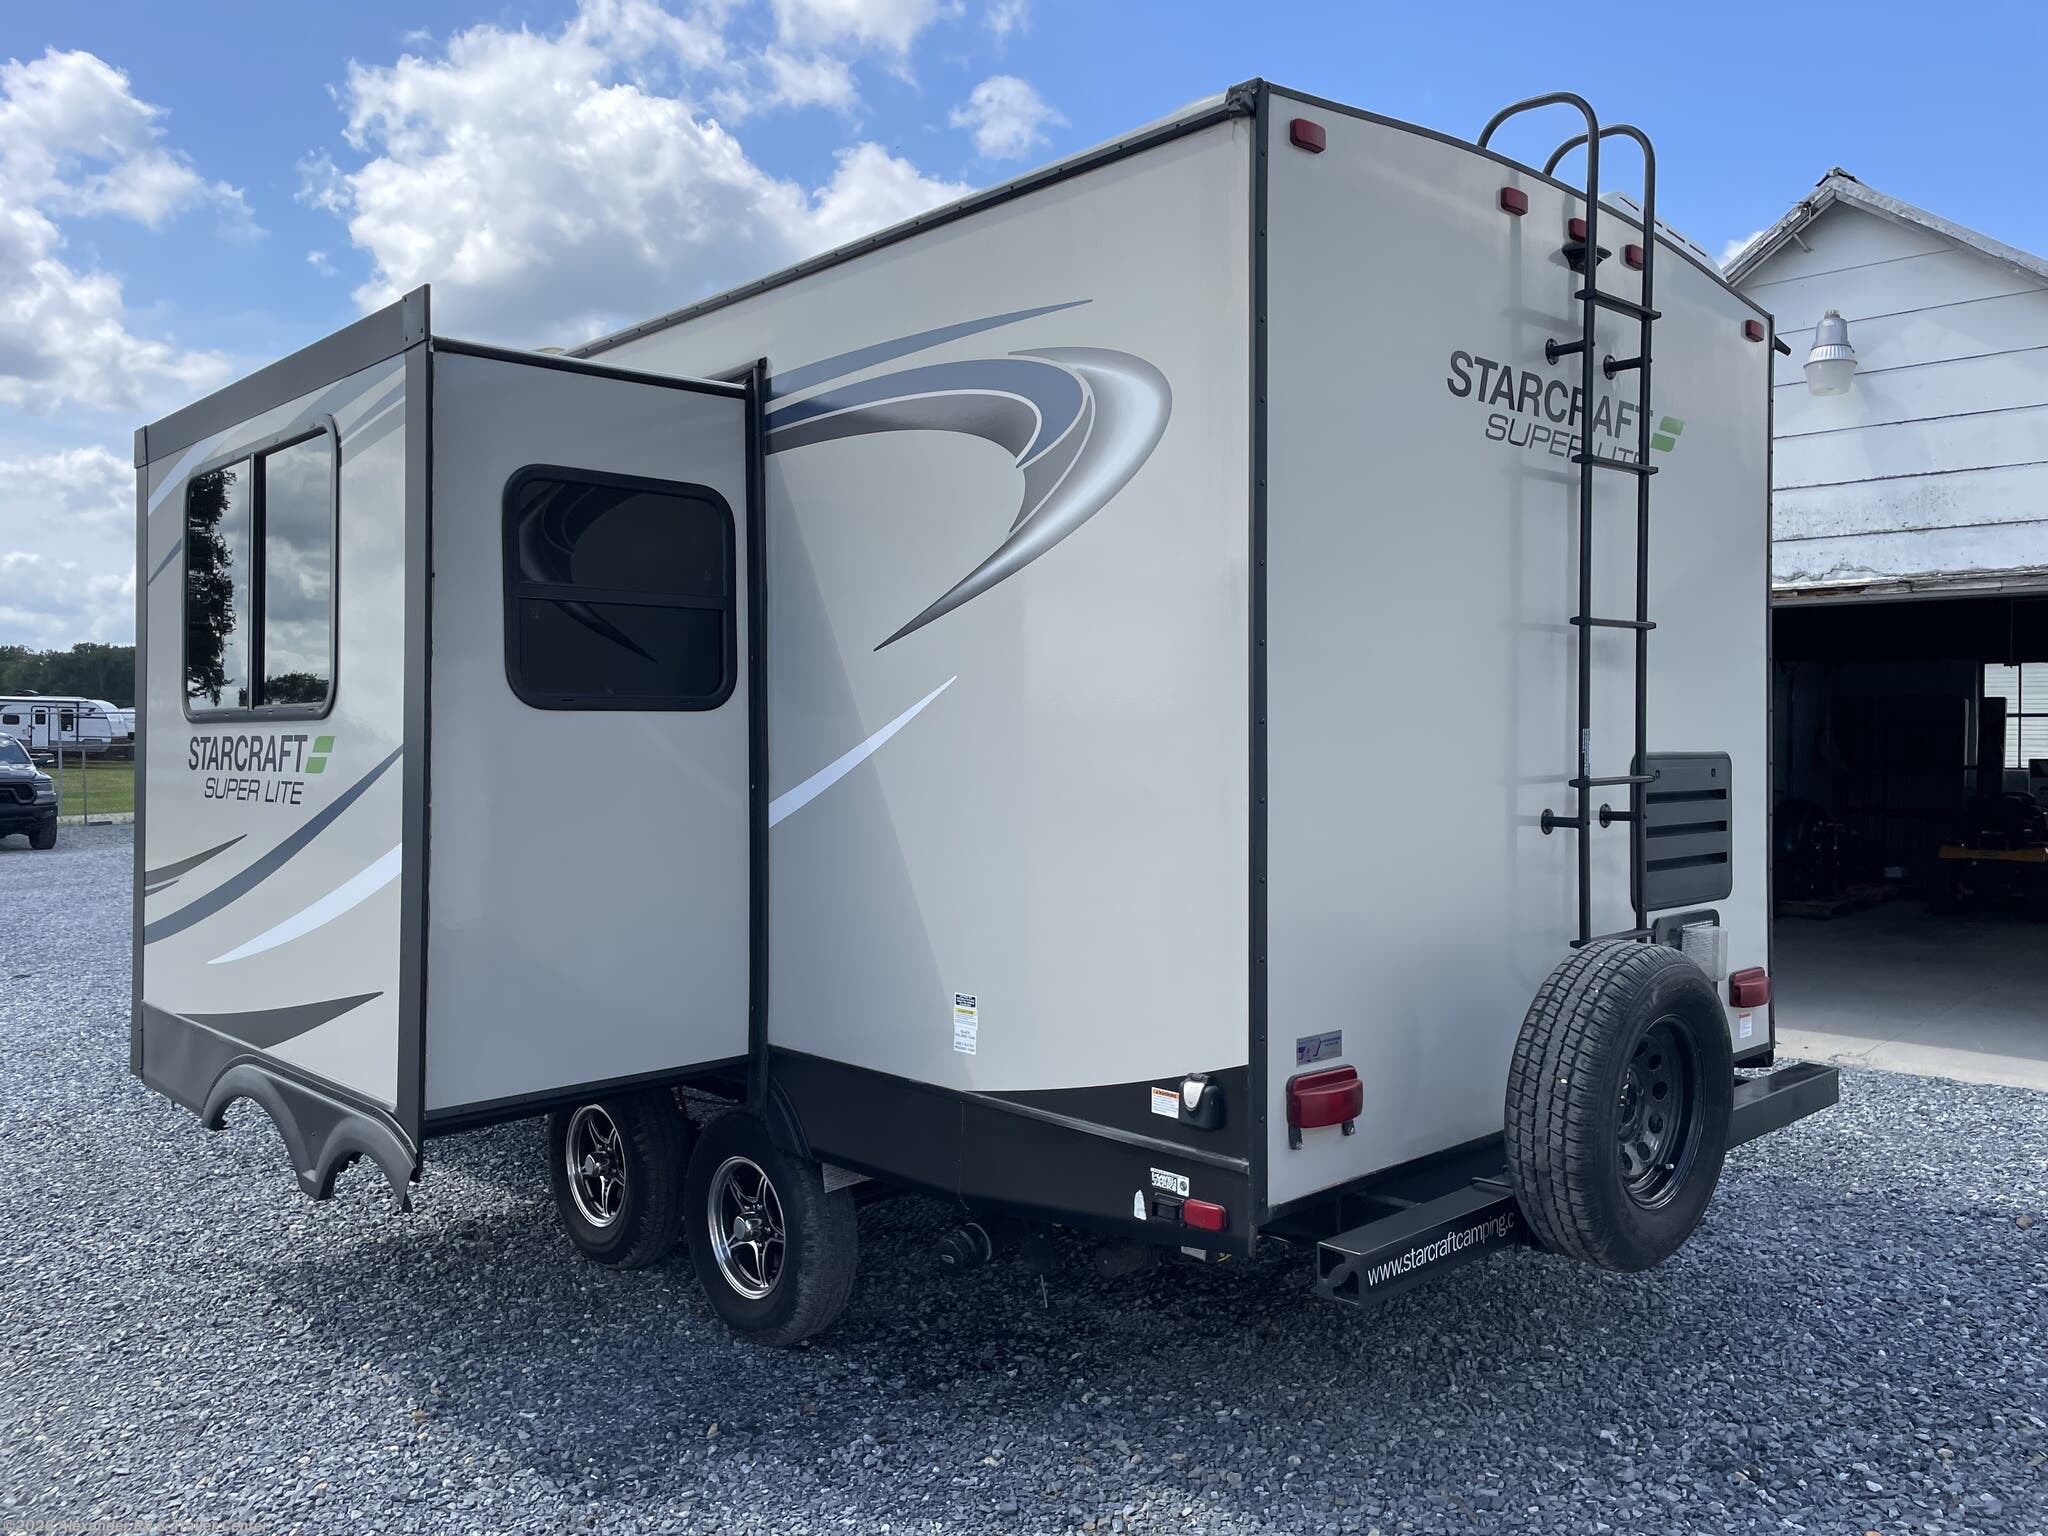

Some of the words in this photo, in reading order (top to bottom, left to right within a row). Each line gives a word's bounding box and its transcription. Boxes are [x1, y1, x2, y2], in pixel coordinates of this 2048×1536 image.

[188, 734, 308, 772] STARCRAFT
[204, 777, 260, 802] SUPER
[264, 779, 304, 805] LITE
